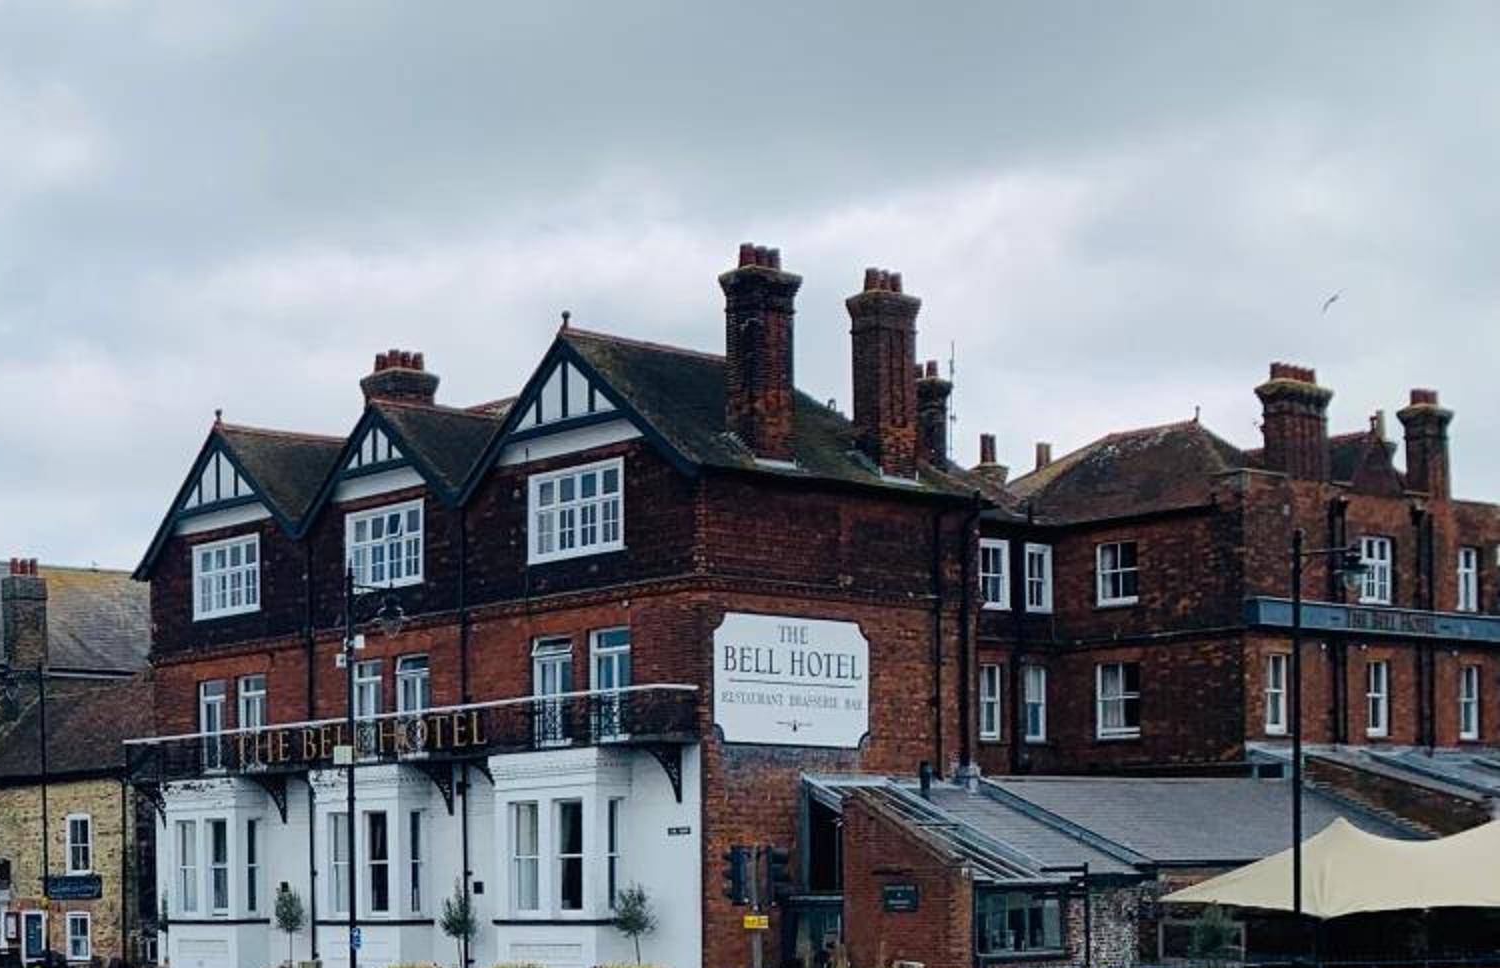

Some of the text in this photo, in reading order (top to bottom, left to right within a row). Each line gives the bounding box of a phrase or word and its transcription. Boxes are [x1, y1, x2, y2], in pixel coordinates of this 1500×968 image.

[778, 624, 809, 645] THE
[723, 645, 863, 681] BELL HOTEL
[234, 730, 292, 766] THE
[378, 710, 489, 753] HOTEL
